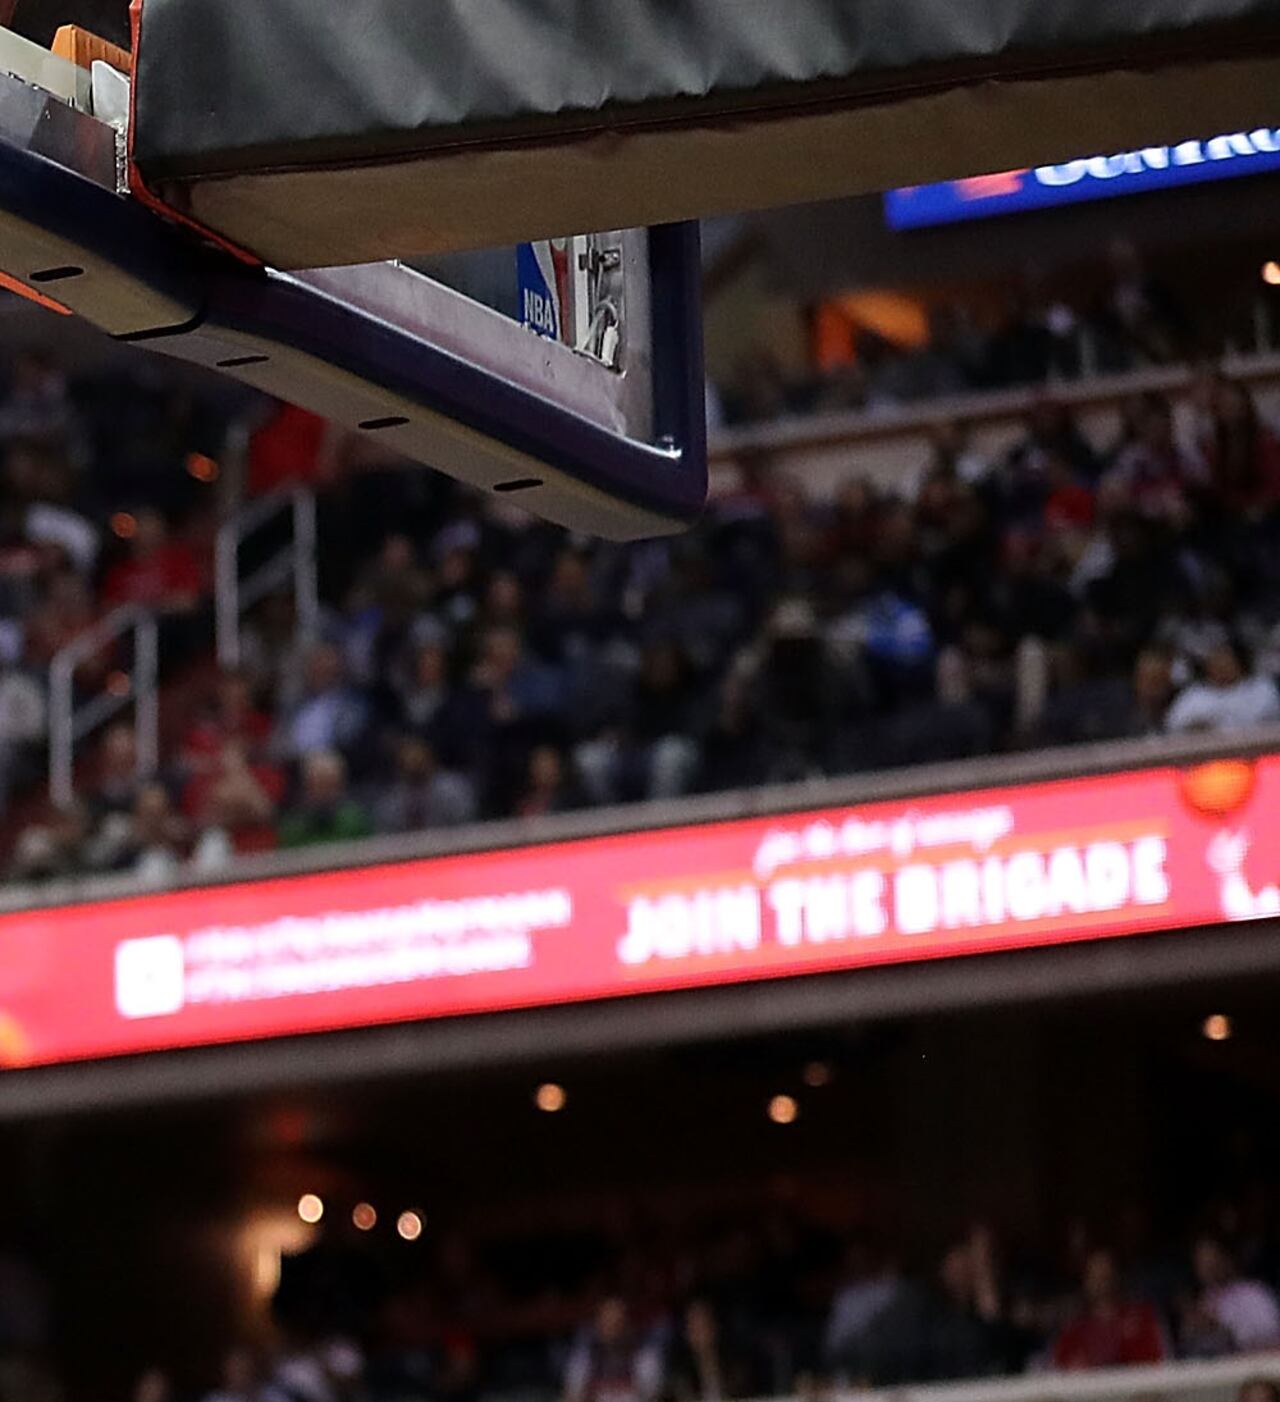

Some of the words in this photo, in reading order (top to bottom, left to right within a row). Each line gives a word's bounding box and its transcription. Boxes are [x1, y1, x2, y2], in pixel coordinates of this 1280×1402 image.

[523, 287, 555, 335] NBA
[618, 884, 759, 965] JOIN
[769, 868, 887, 946] THE
[895, 834, 1170, 935] BRIGADE
